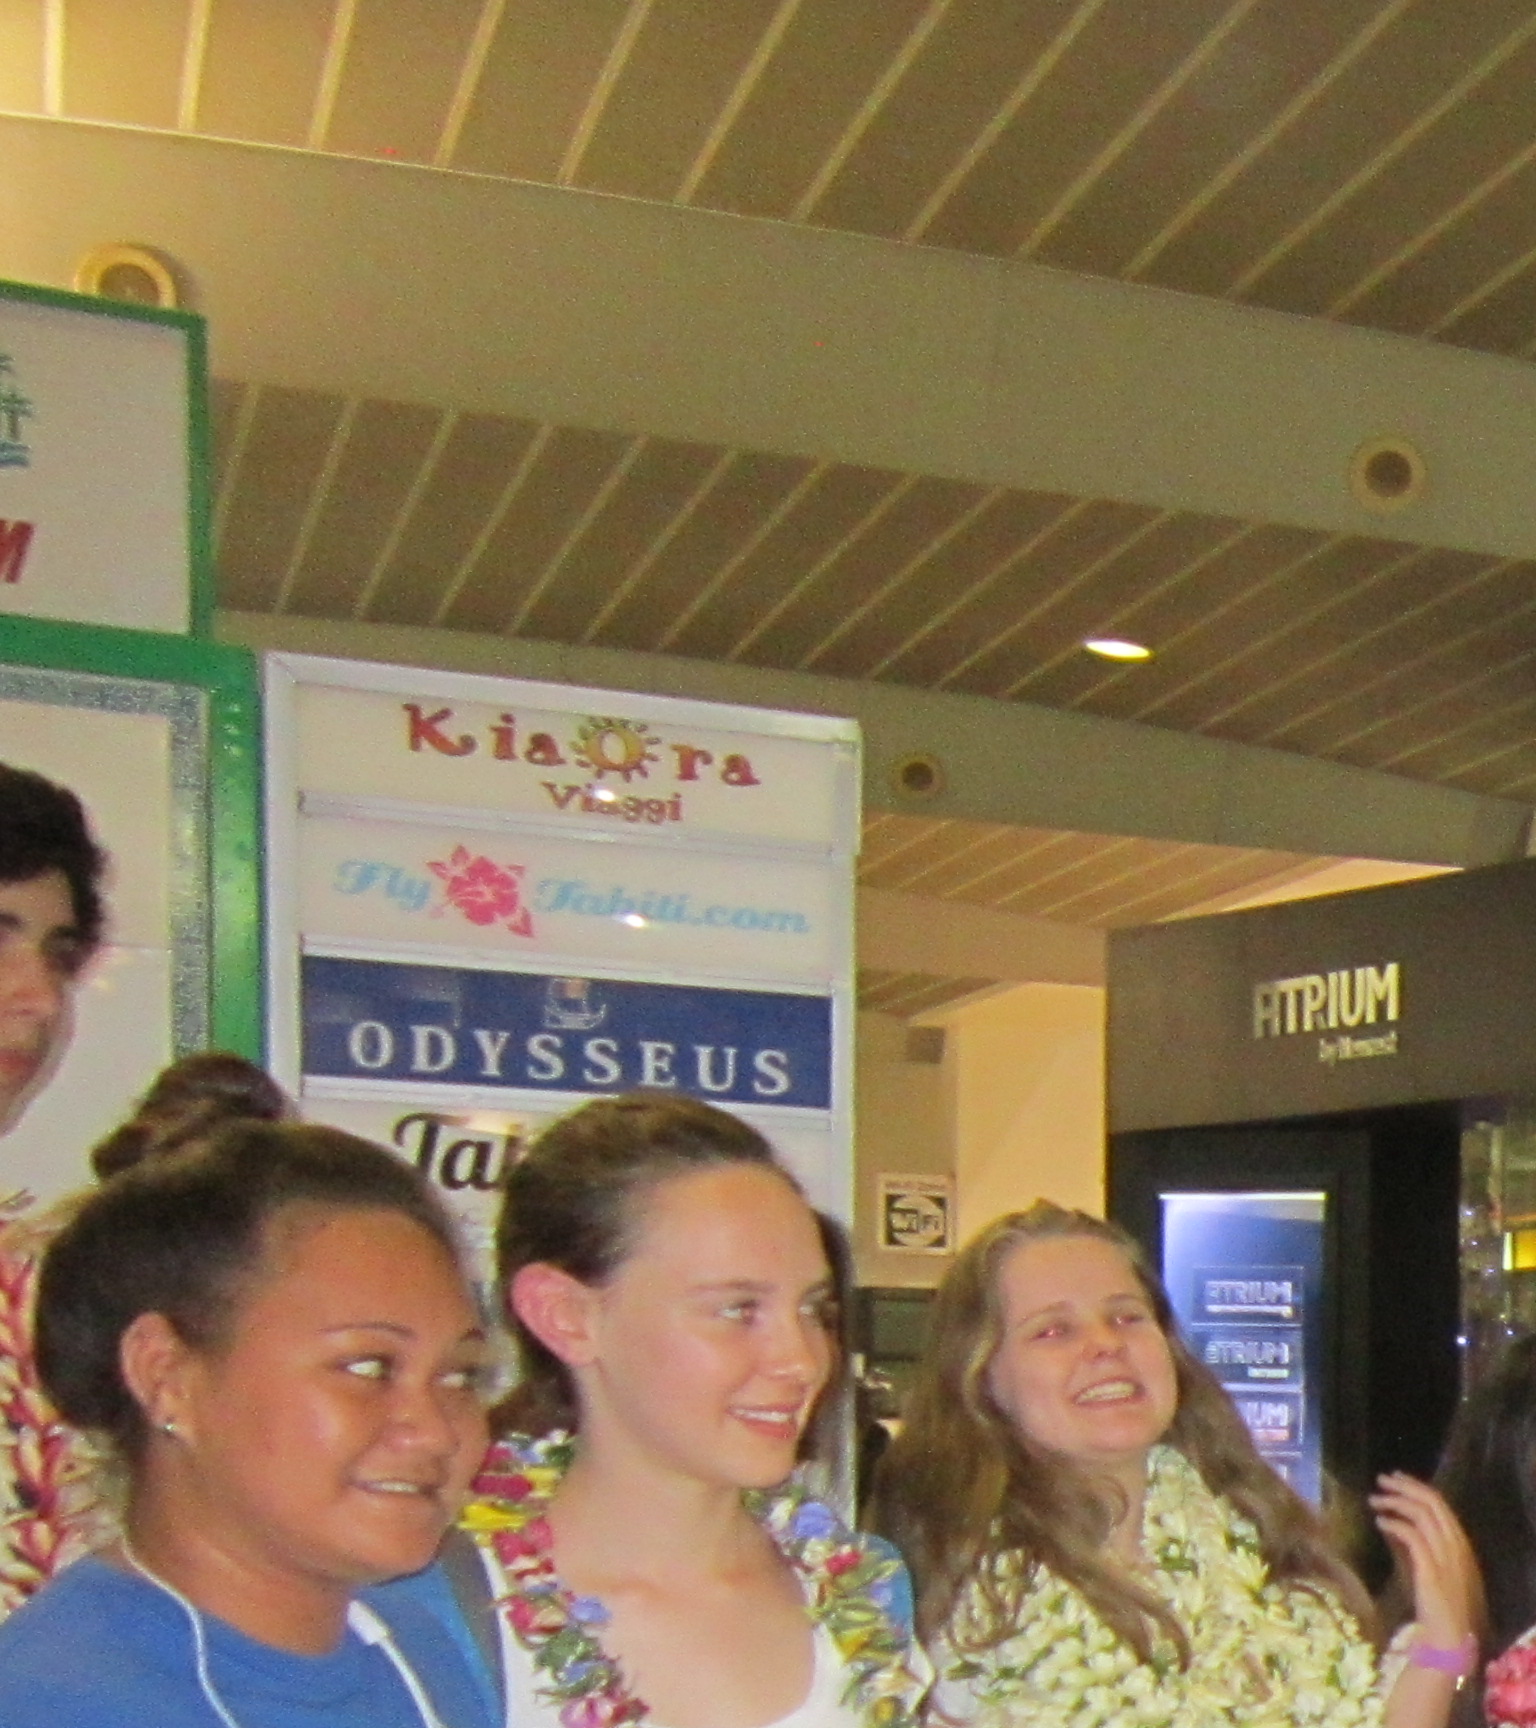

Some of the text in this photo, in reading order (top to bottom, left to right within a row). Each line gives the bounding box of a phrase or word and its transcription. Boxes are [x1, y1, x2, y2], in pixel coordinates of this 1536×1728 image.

[540, 781, 684, 824] Viaggi
[332, 860, 432, 913] Fly
[1253, 962, 1400, 1039] ATRIUM
[350, 1020, 792, 1096] ODYSSEUS
